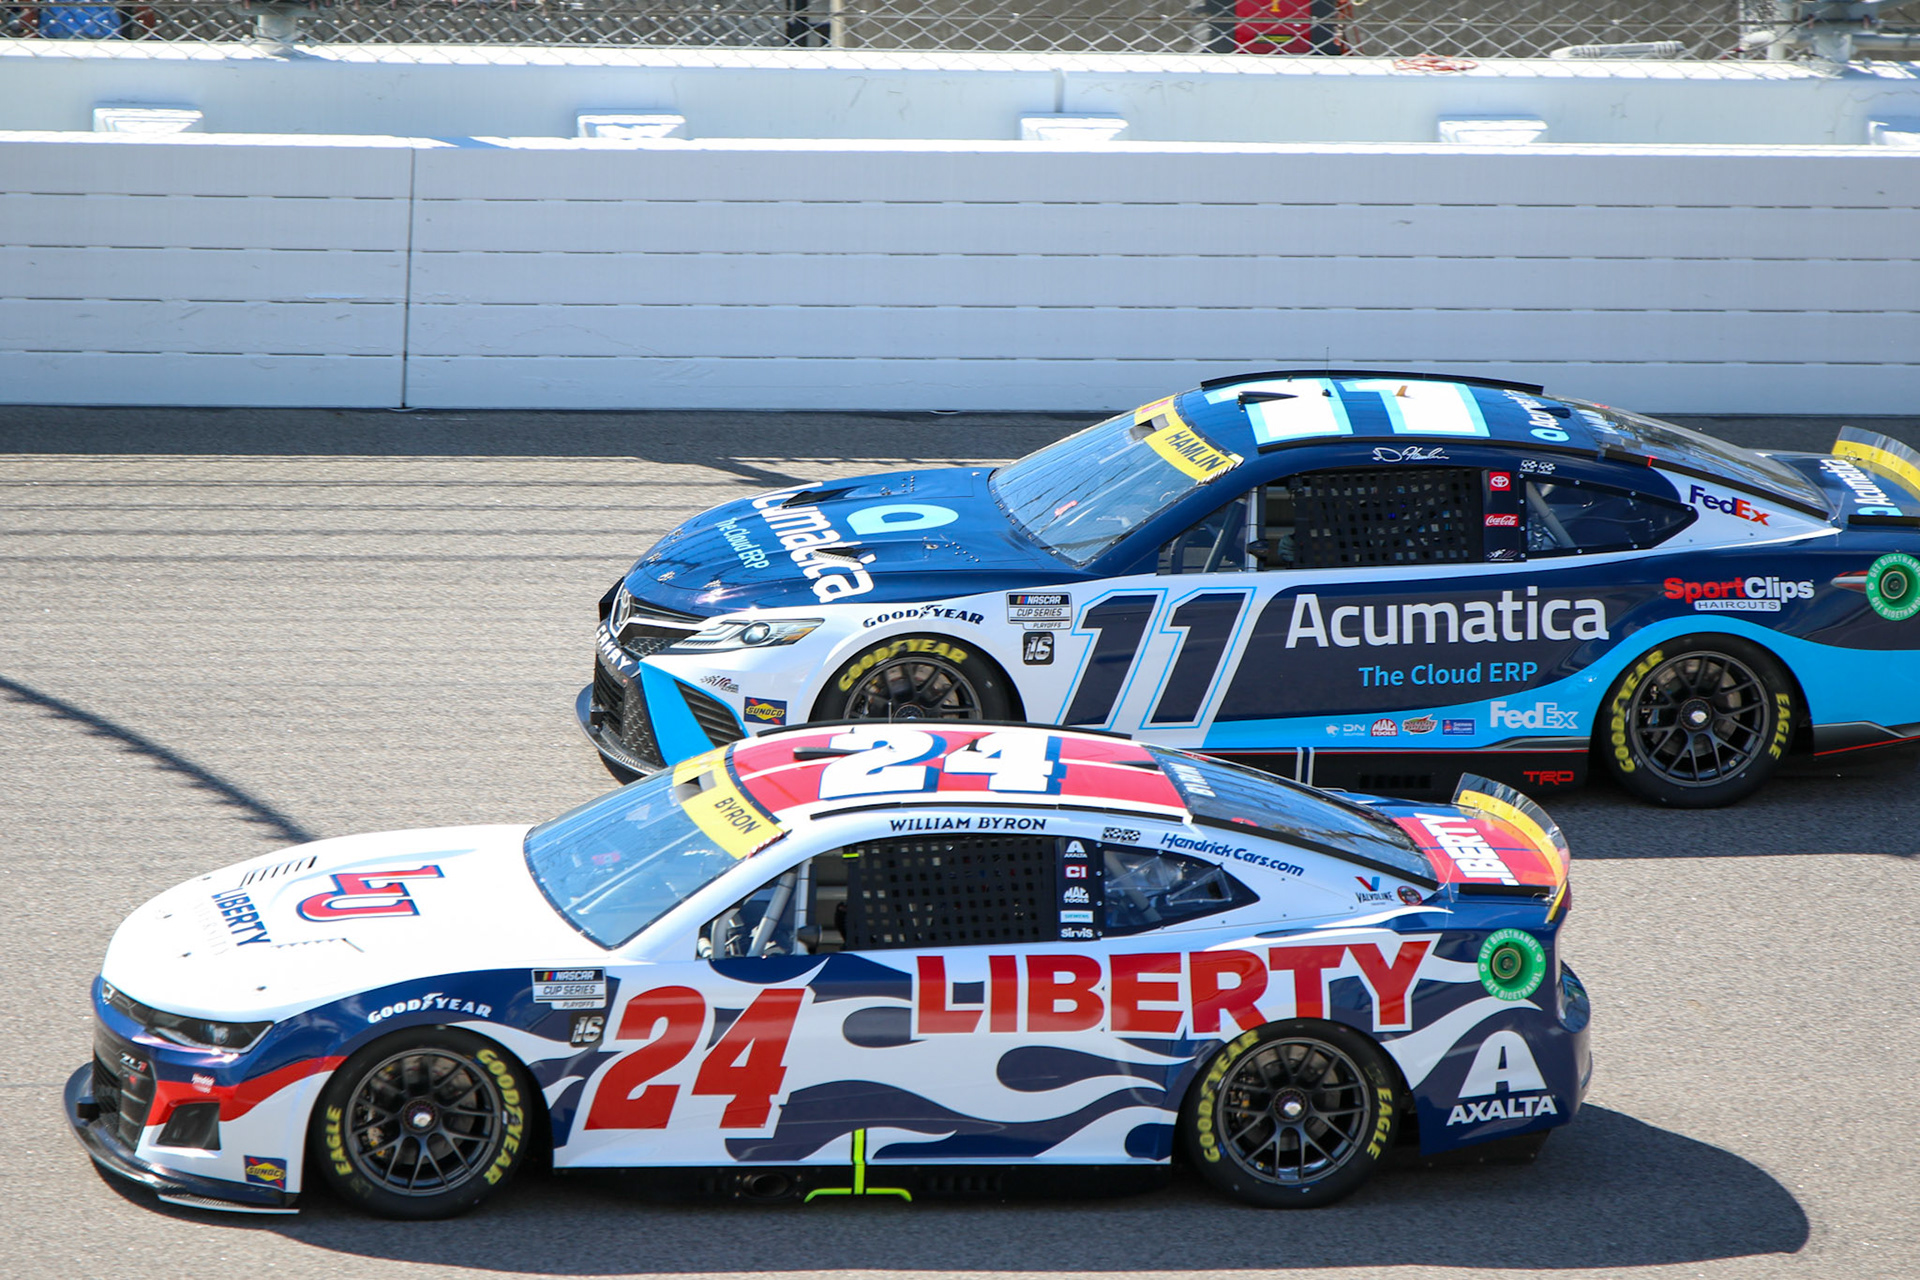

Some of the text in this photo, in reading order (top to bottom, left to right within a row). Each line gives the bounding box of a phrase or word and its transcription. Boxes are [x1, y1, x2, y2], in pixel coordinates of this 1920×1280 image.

[1164, 429, 1226, 472] HAMLIN
[1689, 484, 1770, 527] FedEx
[723, 528, 761, 552] Cloud
[738, 548, 770, 569] ERP
[1016, 608, 1063, 617] CUP SERIES
[1027, 595, 1061, 605] NASCAR
[1697, 601, 1778, 611] HAIRCUTS
[862, 604, 985, 629] GOODYEAR
[1285, 585, 1610, 650] Acumatica
[838, 638, 969, 692] GOODYEAR
[1057, 588, 1254, 729] 11
[1358, 661, 1538, 687] The Cloud ERP
[747, 707, 784, 717] SUNOCO
[1372, 719, 1397, 731] MAC
[1490, 701, 1579, 729] FedEx
[1611, 649, 1664, 773] GOODYEAR
[1768, 692, 1791, 760] EAGLE
[1343, 724, 1366, 732] DN
[818, 729, 1067, 800] 24
[1523, 770, 1575, 786] TRD
[714, 797, 762, 836] BYRON
[889, 817, 1048, 832] WILLIAM BYRON
[1066, 866, 1087, 878] CI
[1064, 886, 1090, 899] MAC
[211, 887, 272, 947] LIBERTY
[1480, 929, 1538, 959] GET BIOETHANOL
[543, 985, 596, 996] CUP SERIES
[555, 971, 596, 981] NASCAR
[914, 938, 1437, 1037] LIBERTY
[1485, 972, 1542, 1000] GET BIOETHANOL
[367, 992, 492, 1024] GOODYEAR
[584, 986, 810, 1131] 24
[1197, 1029, 1261, 1164] GOODYEAR
[1446, 1095, 1558, 1126] AXALTA
[476, 1049, 525, 1185] GOODYEAR
[1366, 1086, 1393, 1160] EAGLE
[325, 1105, 352, 1176] EAGLE
